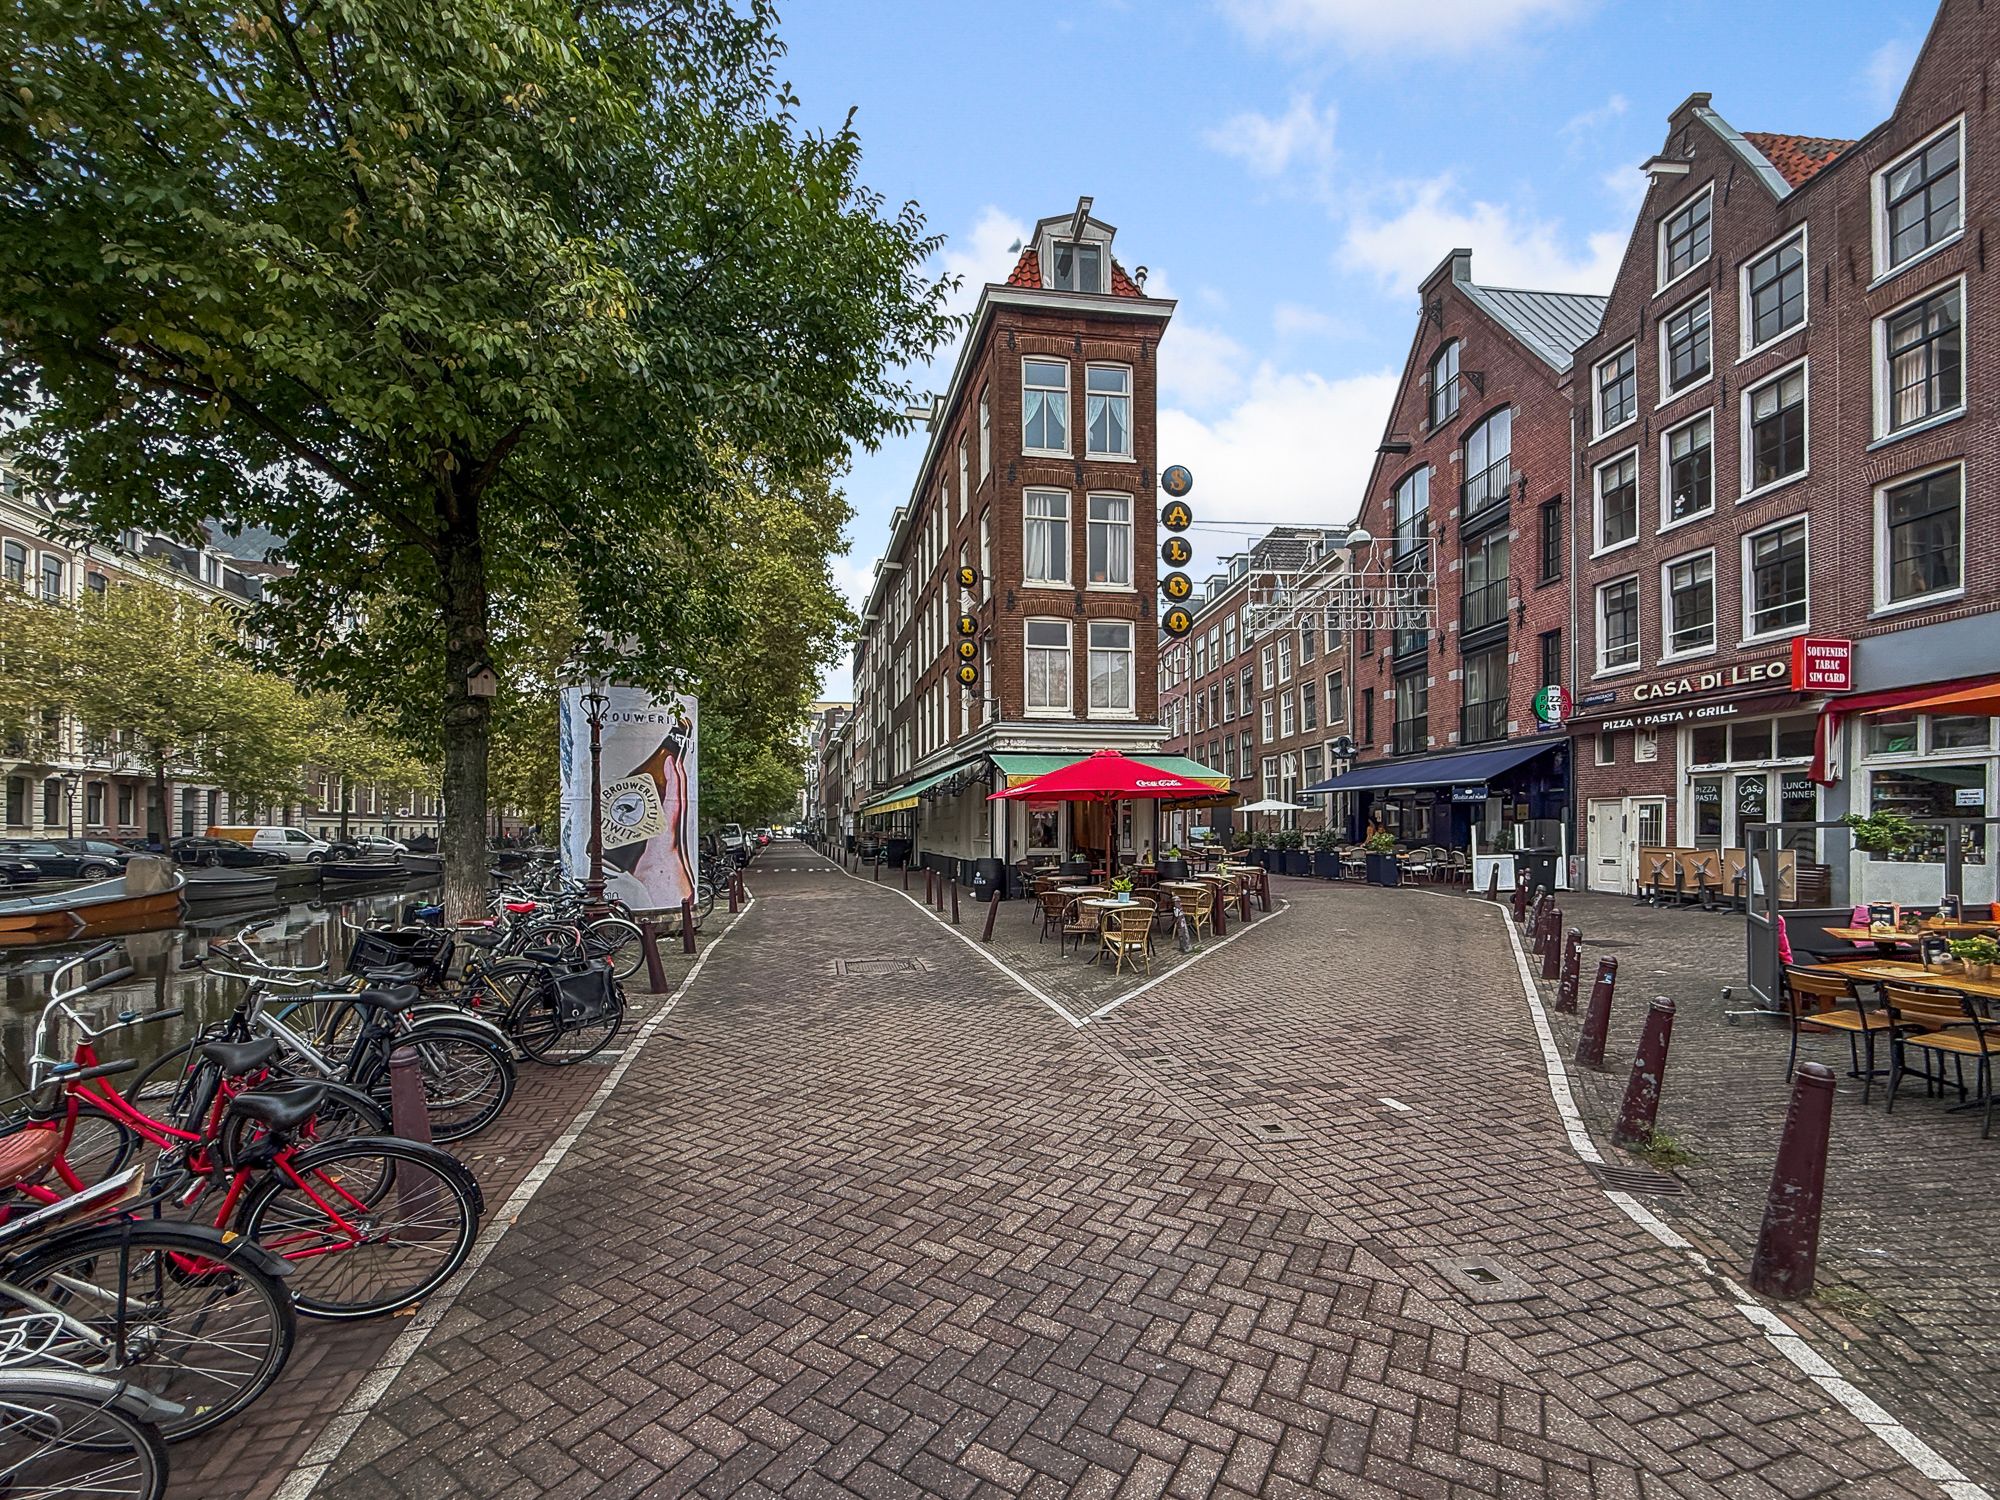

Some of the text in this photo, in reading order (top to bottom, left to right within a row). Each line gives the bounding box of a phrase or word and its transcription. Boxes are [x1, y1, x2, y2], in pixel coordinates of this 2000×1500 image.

[1807, 646, 1848, 658] SOUVENIRS
[1815, 659, 1840, 670] TABAC
[1633, 661, 1786, 701] CASA DI LEO
[1809, 672, 1846, 683] SIM CARD
[1540, 695, 1568, 703] PIZZA
[1540, 703, 1569, 711] PASTA
[600, 712, 677, 726] ROUWERIJ
[1602, 704, 1738, 730] PIZZA PASTA GRILL
[1695, 785, 1717, 794] PIZZA
[1739, 783, 1764, 796] Casa
[1782, 781, 1811, 791] LUNCH
[1695, 794, 1718, 802] PASTA
[1782, 790, 1816, 800] DINNER
